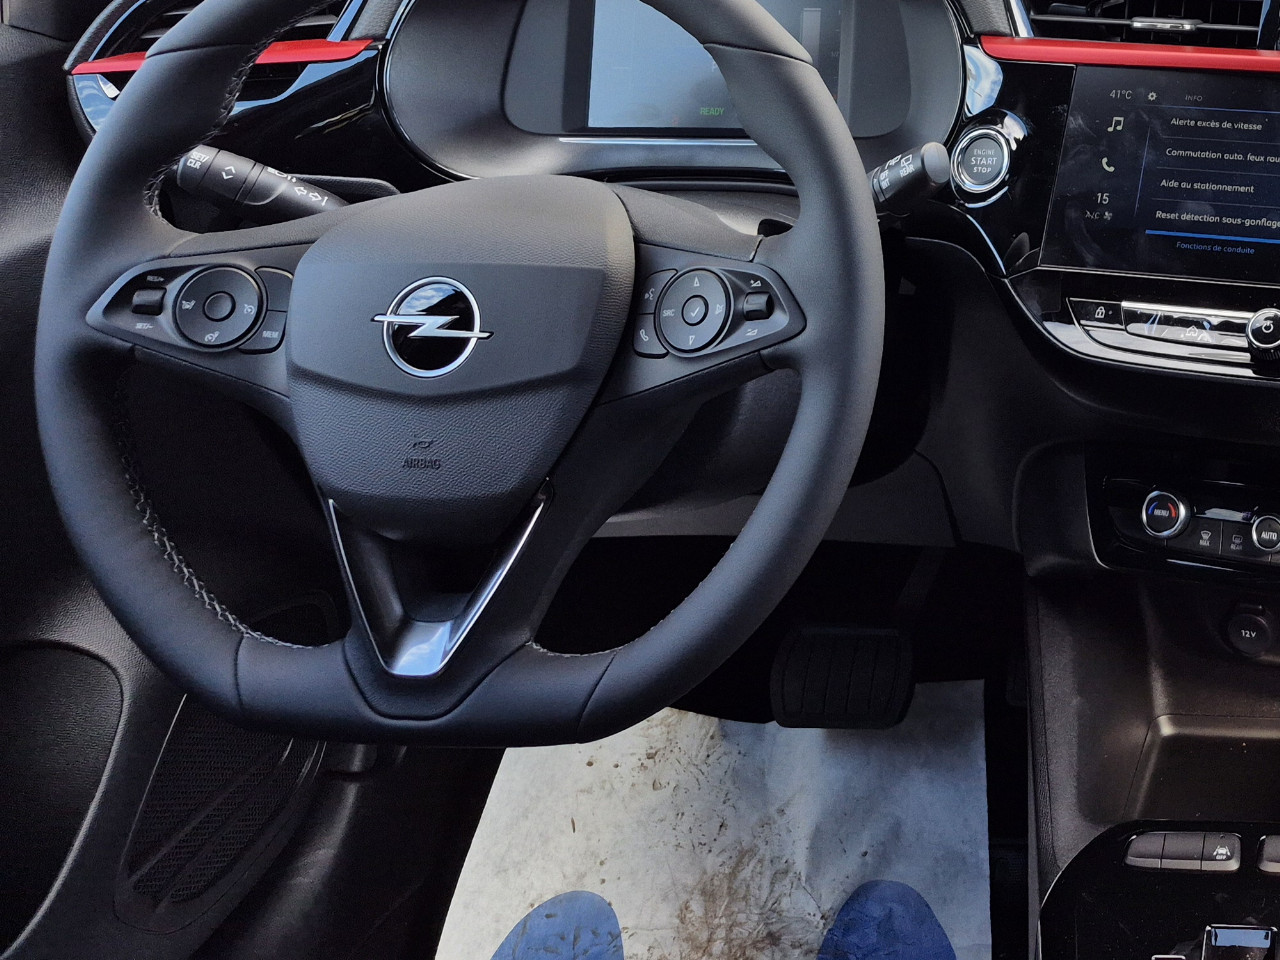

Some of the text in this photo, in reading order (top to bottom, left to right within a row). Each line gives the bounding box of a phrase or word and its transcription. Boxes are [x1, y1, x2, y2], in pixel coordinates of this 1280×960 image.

[1109, 89, 1133, 100] 41°C
[700, 107, 725, 116] READY
[1170, 117, 1263, 131] Alerte excès de vitesse
[973, 148, 995, 156] ENGINE
[1165, 147, 1222, 159] Commutation
[1247, 152, 1265, 162] feux
[971, 157, 998, 166] START
[973, 166, 992, 174] STOP
[1160, 179, 1179, 188] Aide
[1193, 182, 1255, 193] stationnement
[1096, 192, 1110, 205] 15
[1155, 210, 1180, 220] Reset
[1180, 211, 1220, 223] détection
[1176, 241, 1256, 254] Fonctions de conduite
[662, 308, 676, 318] SRC
[262, 330, 279, 339] MEM
[402, 457, 442, 470] AIRBAG
[1153, 508, 1170, 517] MENU
[1260, 530, 1278, 540] AUTO
[1241, 629, 1257, 638] 12V
